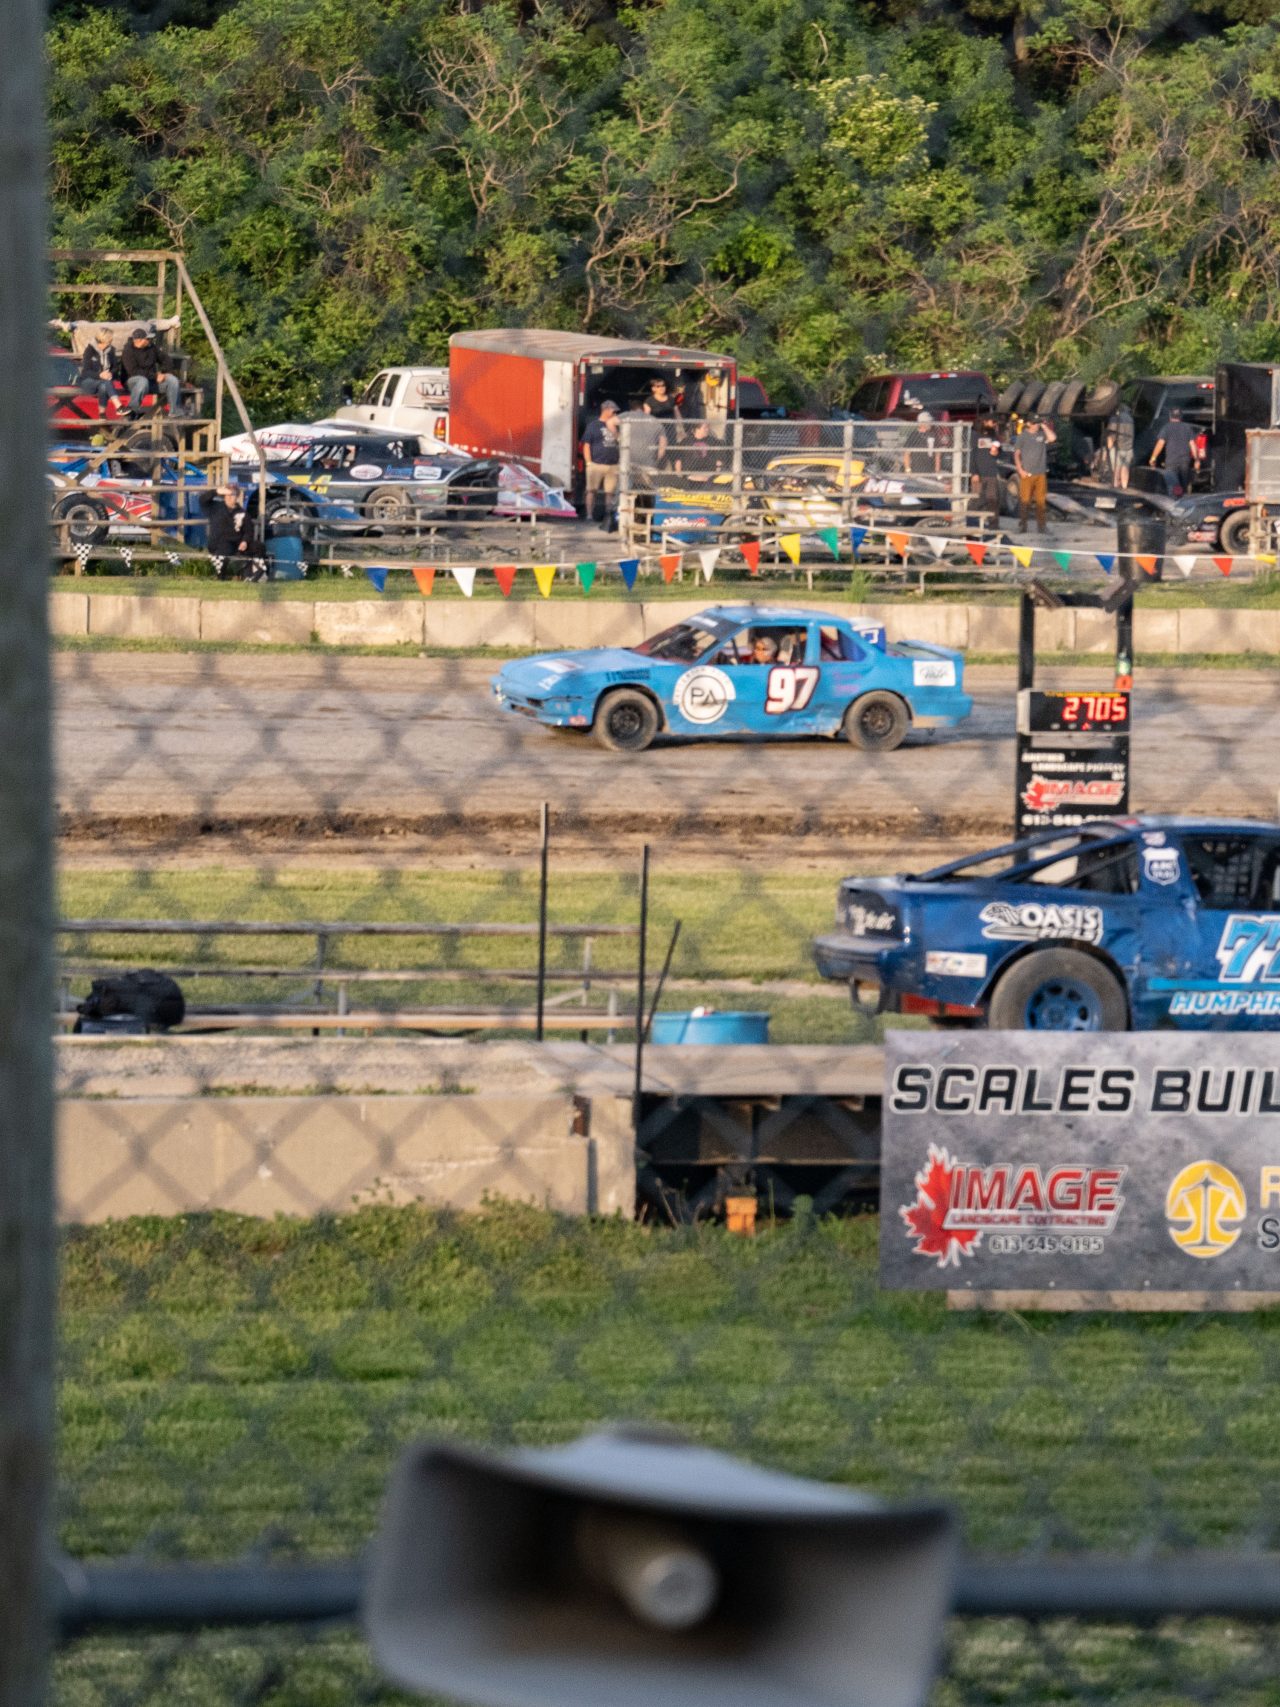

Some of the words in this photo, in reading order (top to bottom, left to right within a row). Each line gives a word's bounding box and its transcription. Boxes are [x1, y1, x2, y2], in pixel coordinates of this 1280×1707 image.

[765, 666, 820, 715] 97
[1062, 697, 1127, 721] 2705
[1044, 782, 1125, 796] IMAGE
[1020, 902, 1101, 929] OASIS
[892, 1064, 1138, 1115] SCALES
[950, 1165, 1127, 1211] IMAGE
